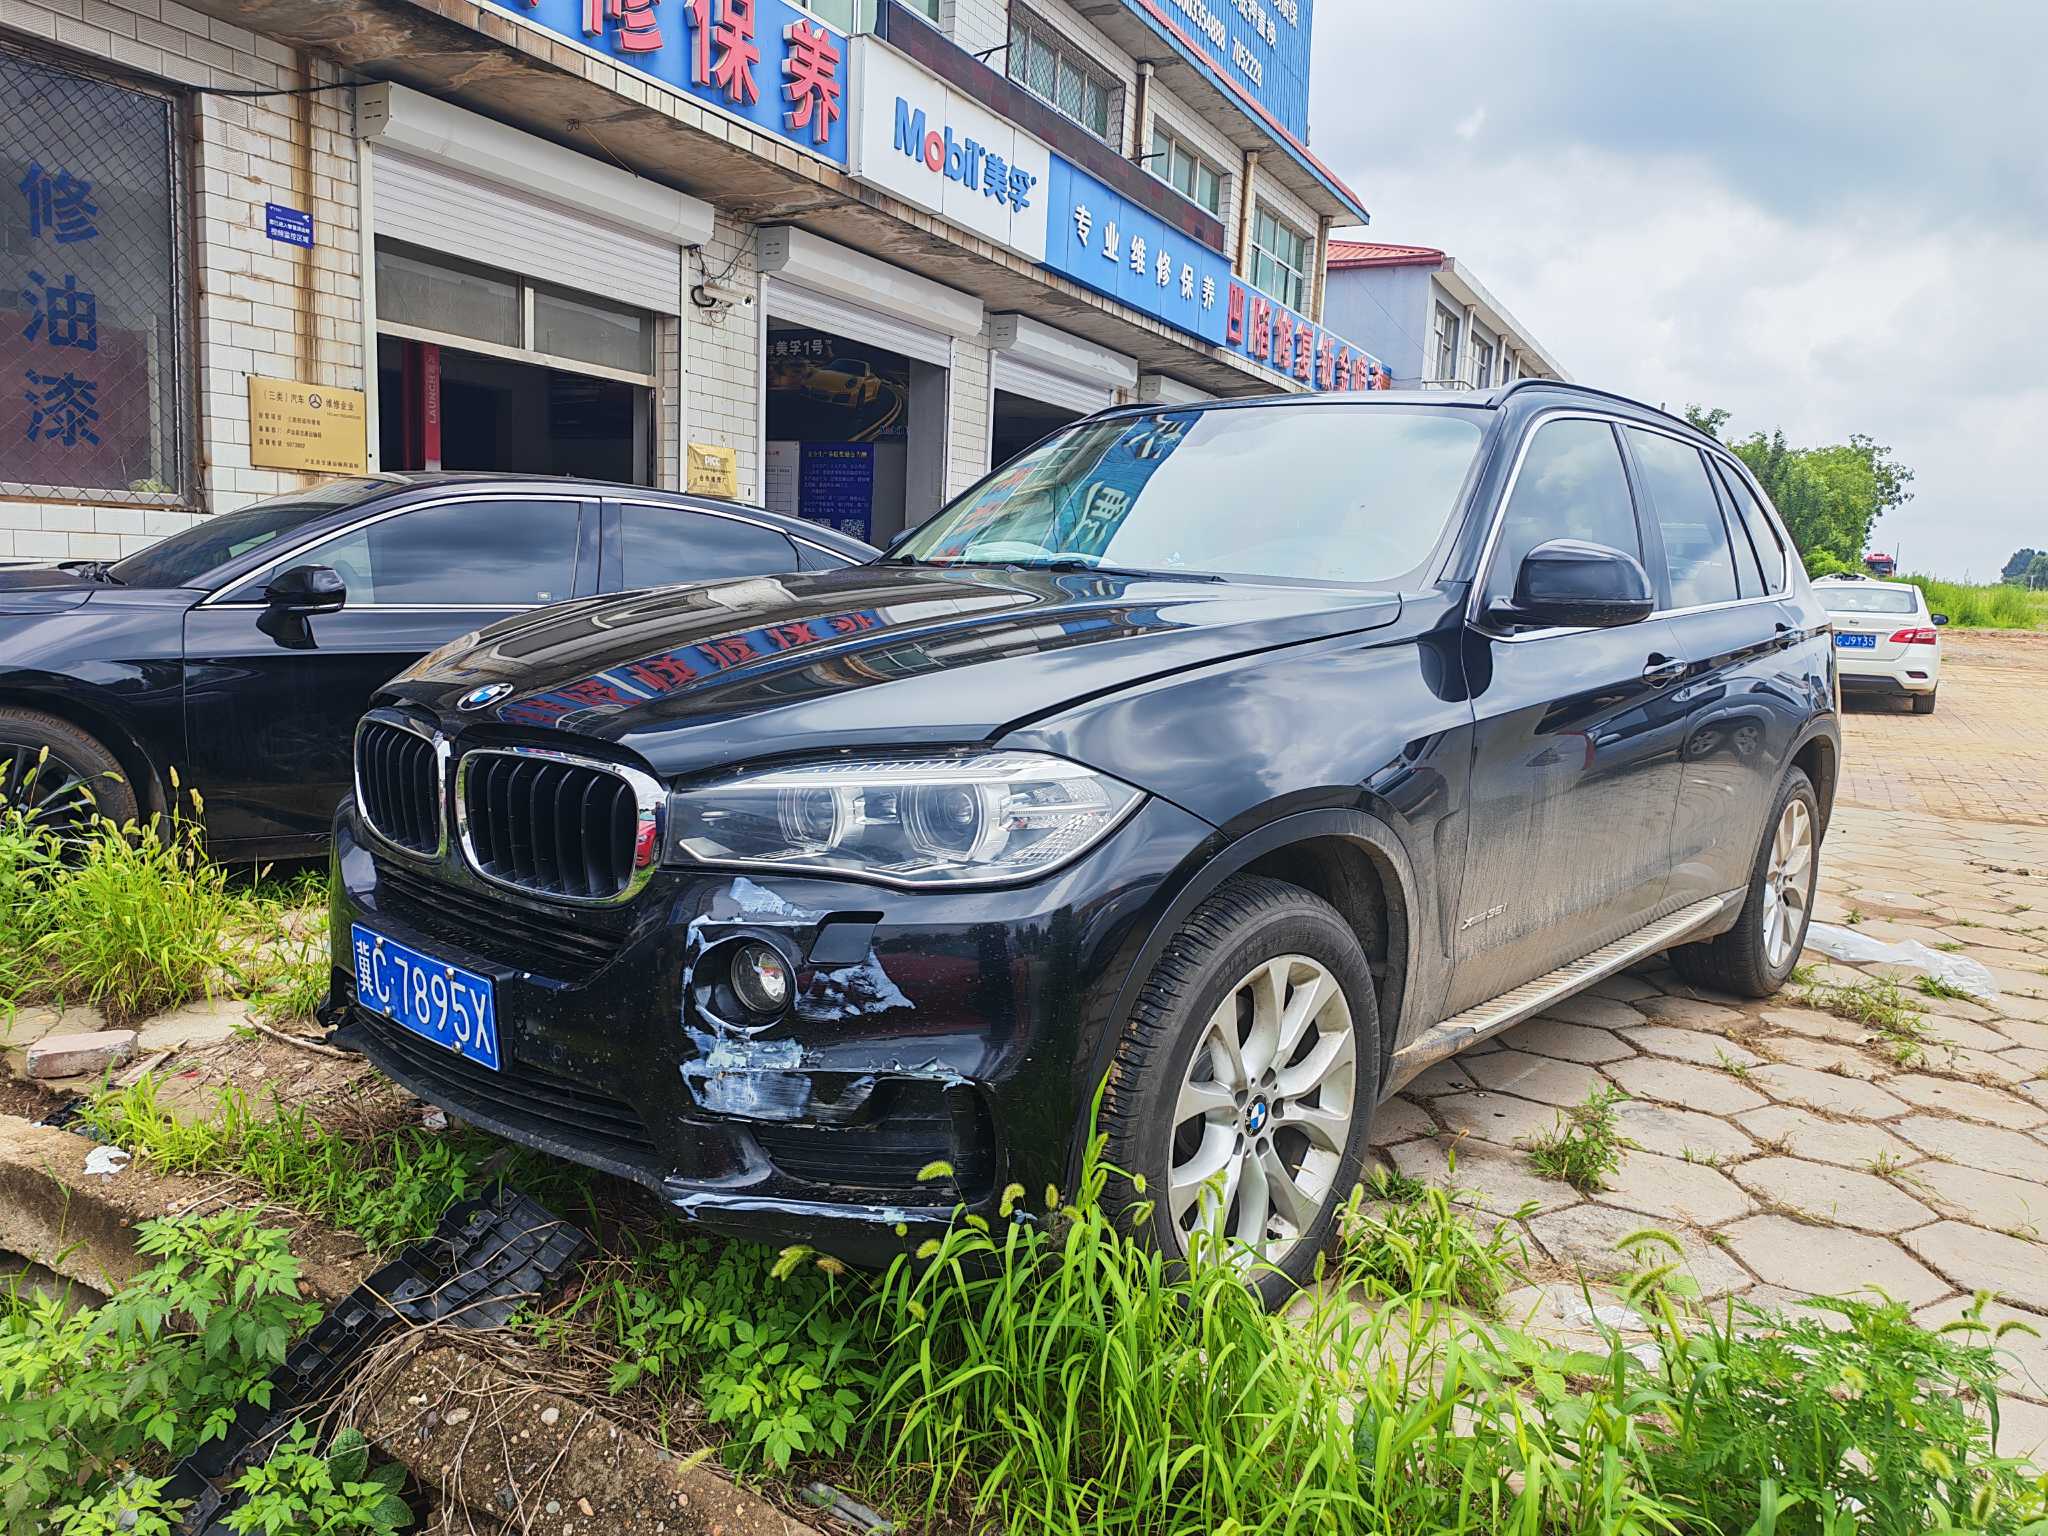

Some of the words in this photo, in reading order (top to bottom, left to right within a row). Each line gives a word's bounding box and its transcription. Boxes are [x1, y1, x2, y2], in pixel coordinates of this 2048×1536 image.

[894, 97, 982, 191] Mobil
[1073, 205, 1216, 311] 专业维修保养
[355, 940, 492, 1055] 冀C·7895X
